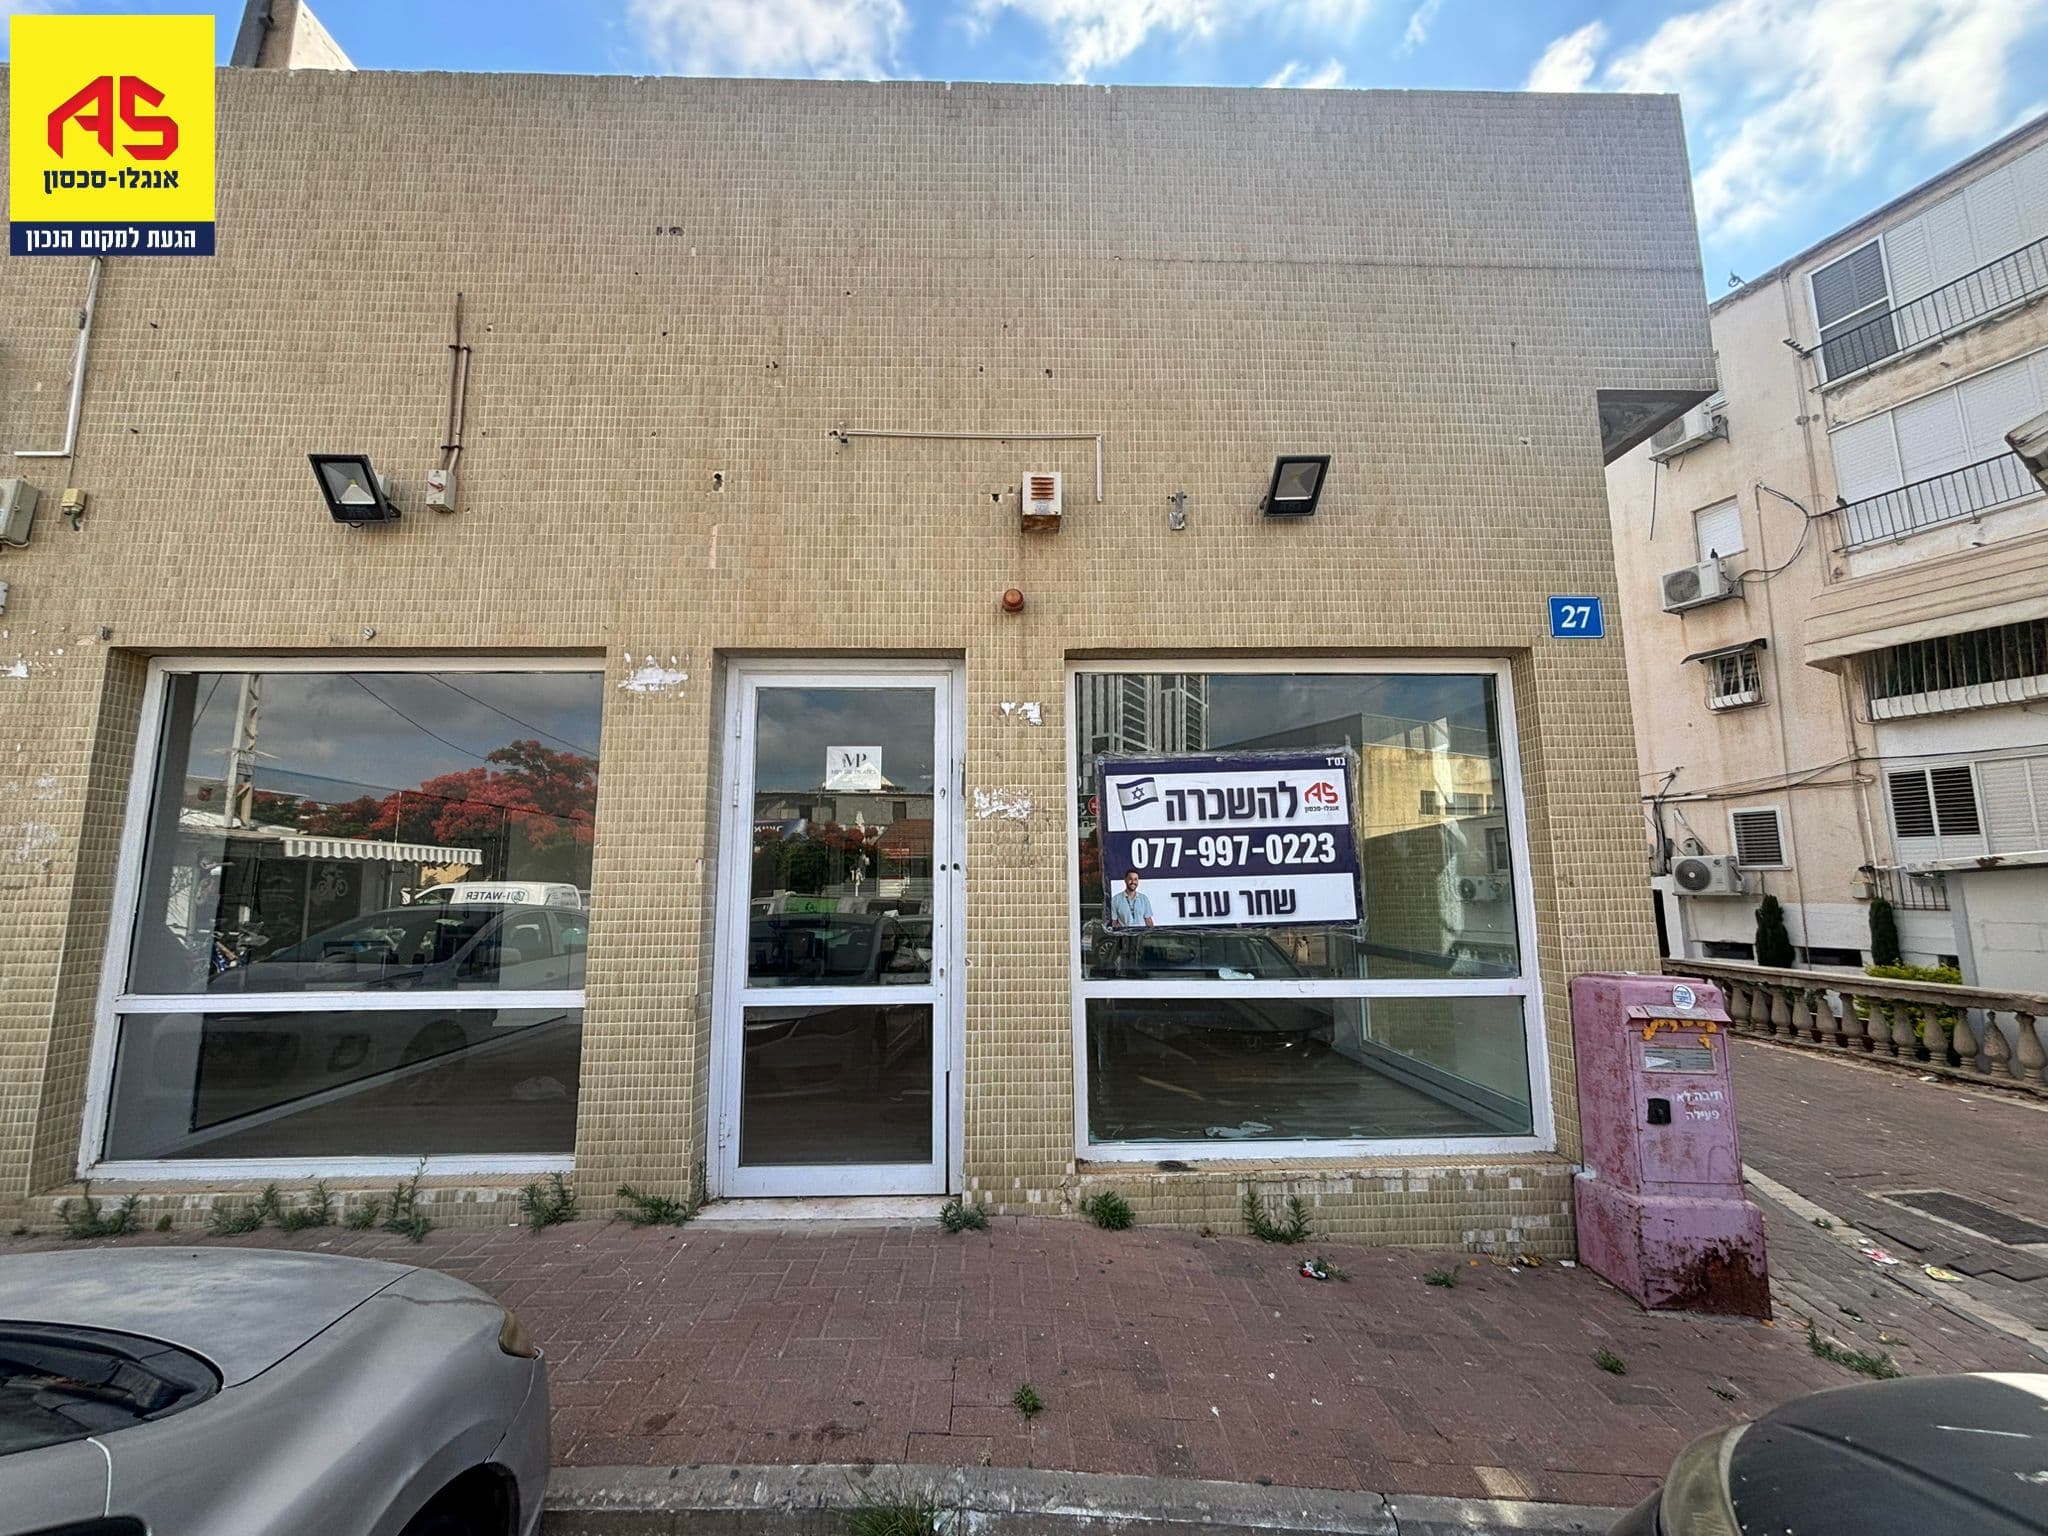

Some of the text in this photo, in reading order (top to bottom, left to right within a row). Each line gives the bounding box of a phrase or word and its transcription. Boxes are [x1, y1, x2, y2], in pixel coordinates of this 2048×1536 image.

[1561, 605, 1591, 629] 27
[1164, 780, 1299, 822] להשכרה
[1304, 781, 1340, 805] AS
[1131, 832, 1336, 869] 077-997-0223
[1170, 887, 1297, 918] שחר עובד
